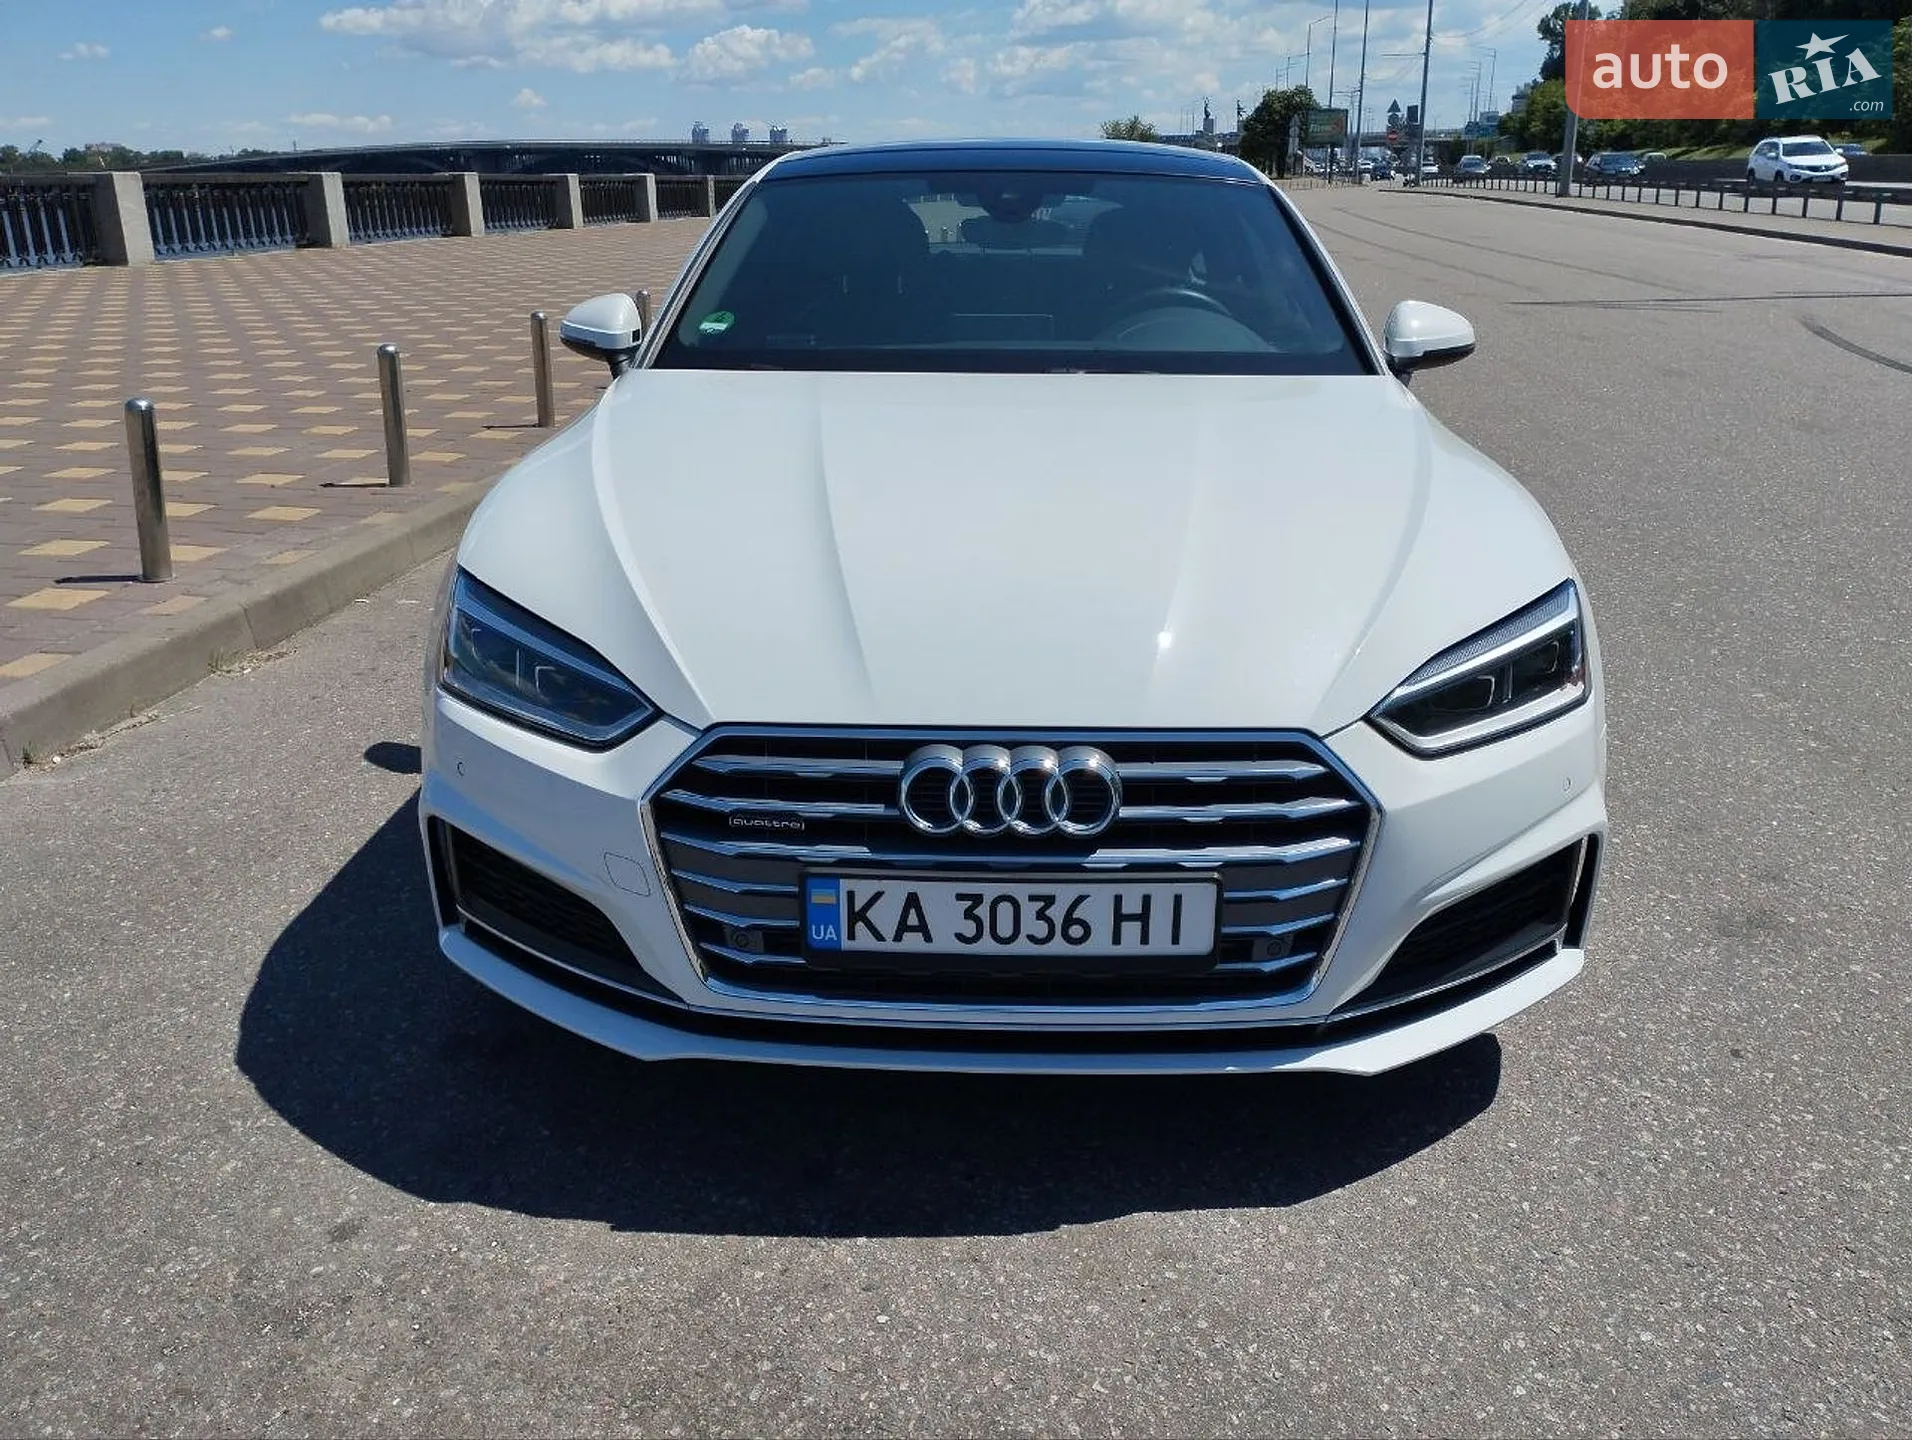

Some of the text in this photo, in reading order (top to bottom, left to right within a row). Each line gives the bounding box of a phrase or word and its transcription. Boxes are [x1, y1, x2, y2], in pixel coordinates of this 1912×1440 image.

[732, 817, 801, 829] quattro
[846, 890, 1183, 946] KA 3036 HI
[811, 924, 837, 942] UA
